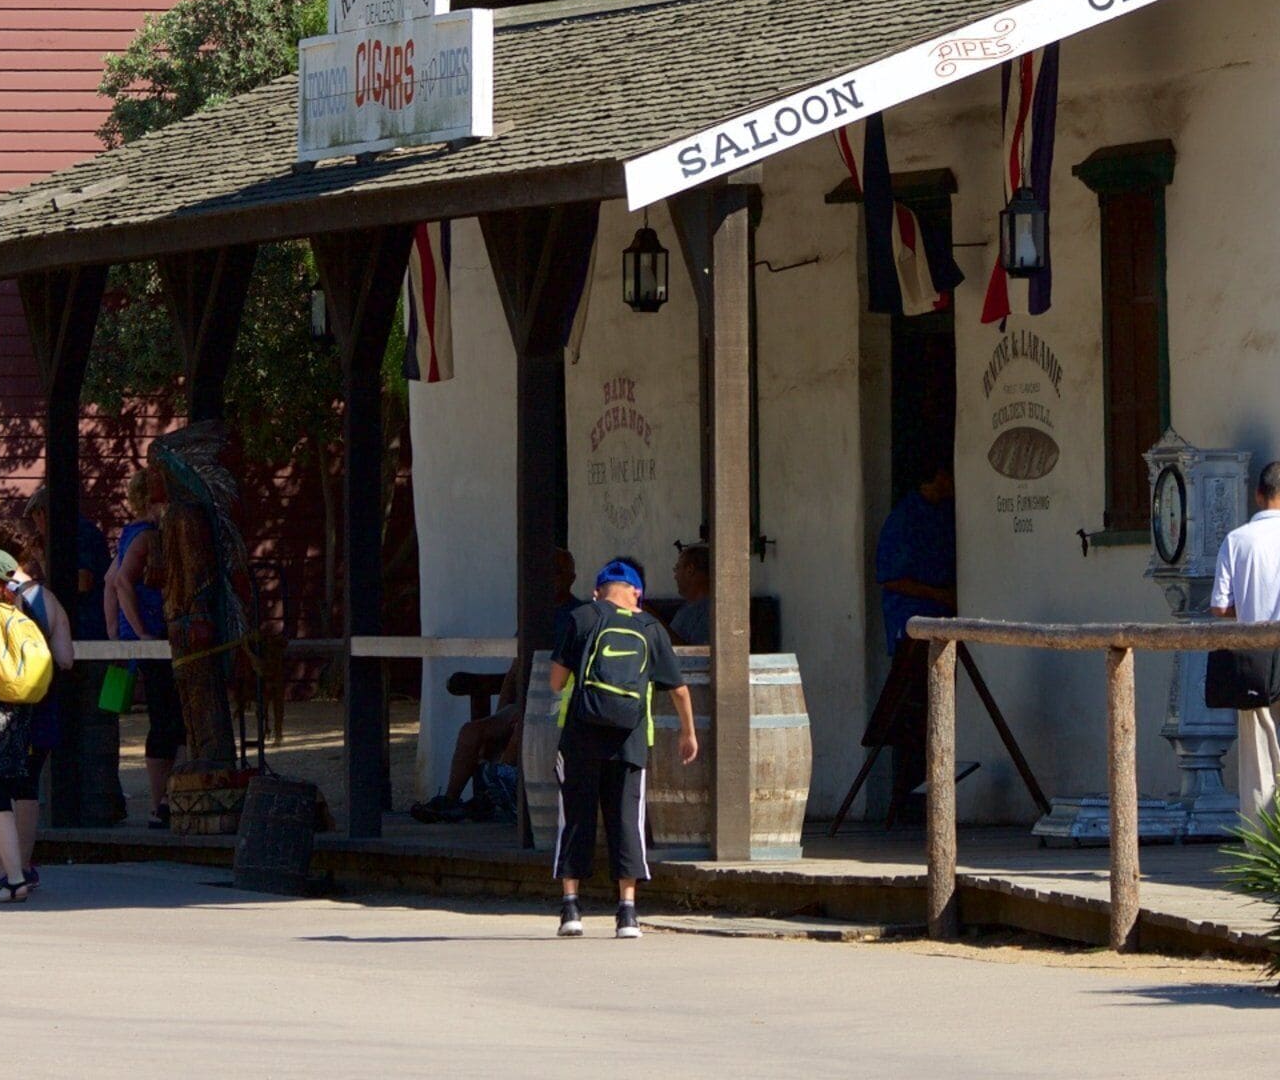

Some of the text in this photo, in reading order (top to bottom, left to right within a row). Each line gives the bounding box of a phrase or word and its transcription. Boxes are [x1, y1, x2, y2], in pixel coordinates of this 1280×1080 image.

[365, 0, 395, 25] DEALERS
[937, 36, 1012, 59] PIPES
[307, 66, 348, 119] TOBACCO
[355, 38, 415, 111] CIGARS
[439, 46, 470, 98] PIPES
[676, 80, 864, 179] SALOON
[983, 335, 1010, 399] RACINE
[1011, 331, 1019, 359] &
[603, 377, 636, 405] BANK
[590, 406, 652, 453] EXCHANGE
[992, 401, 1026, 430] GOLDEN
[609, 456, 629, 483] WINE
